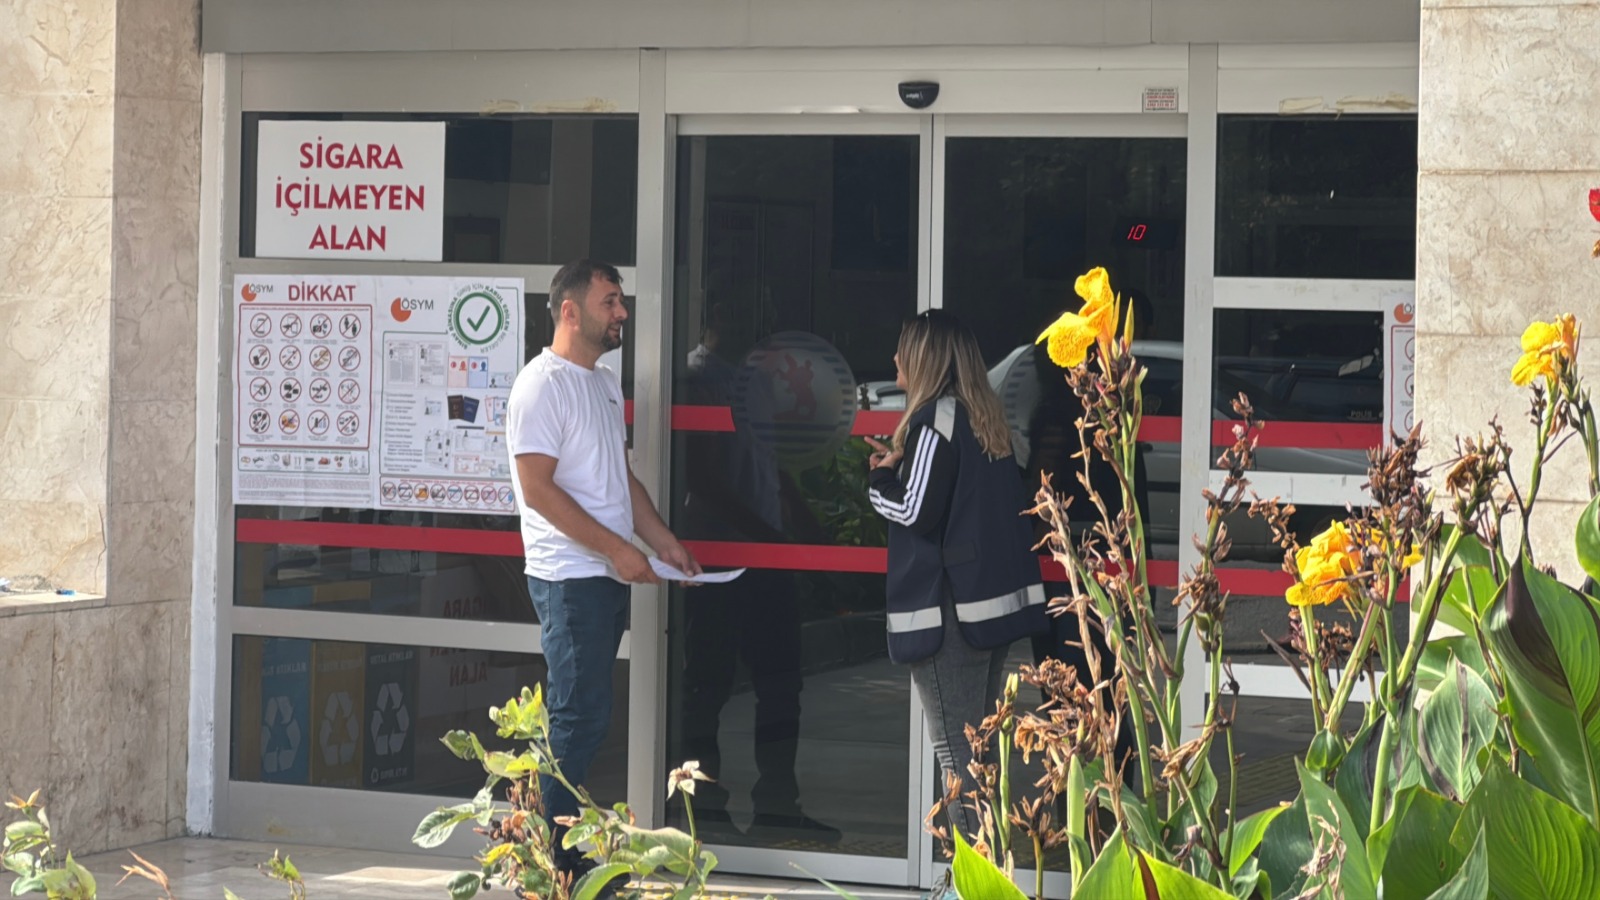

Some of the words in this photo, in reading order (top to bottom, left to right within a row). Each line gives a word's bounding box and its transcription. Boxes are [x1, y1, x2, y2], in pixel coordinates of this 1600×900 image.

[299, 136, 404, 169] SİGARA
[275, 176, 425, 217] İÇİLMEYEN
[308, 224, 386, 252] ALAN
[1127, 224, 1147, 240] 10
[249, 283, 274, 293] ÖSYM
[288, 281, 356, 302] DİKKAT
[401, 297, 434, 311] ÖSYM
